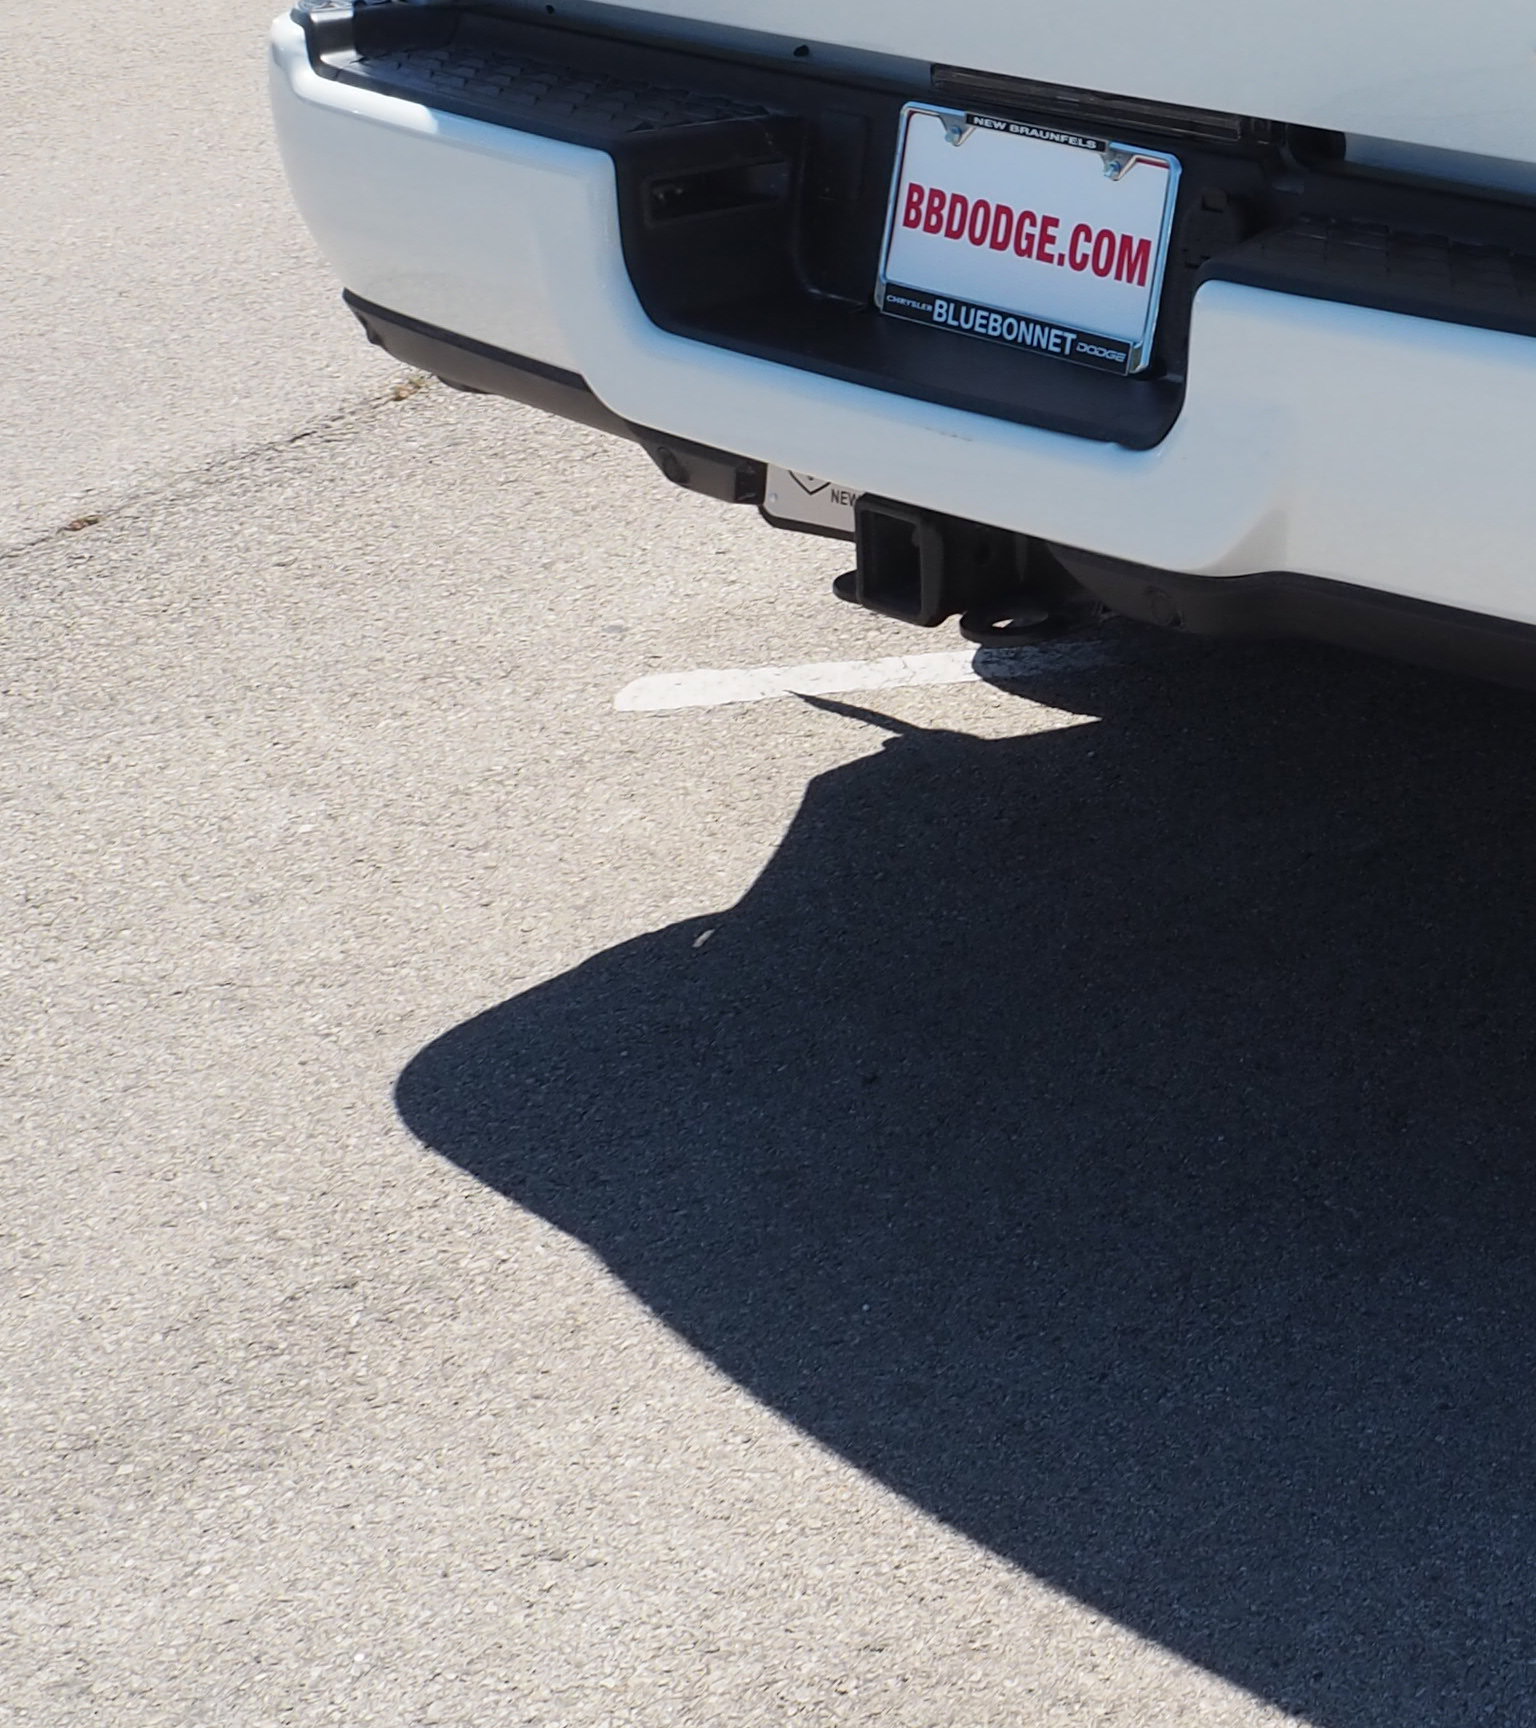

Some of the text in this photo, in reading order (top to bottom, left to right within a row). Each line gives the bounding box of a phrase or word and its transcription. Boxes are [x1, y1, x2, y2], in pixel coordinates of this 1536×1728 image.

[972, 116, 1098, 150] NEW BRAUNFELS
[902, 182, 1152, 288] BBDODGE.COM
[886, 293, 1127, 363] CHRYSLER BLUEBONNET DODGE
